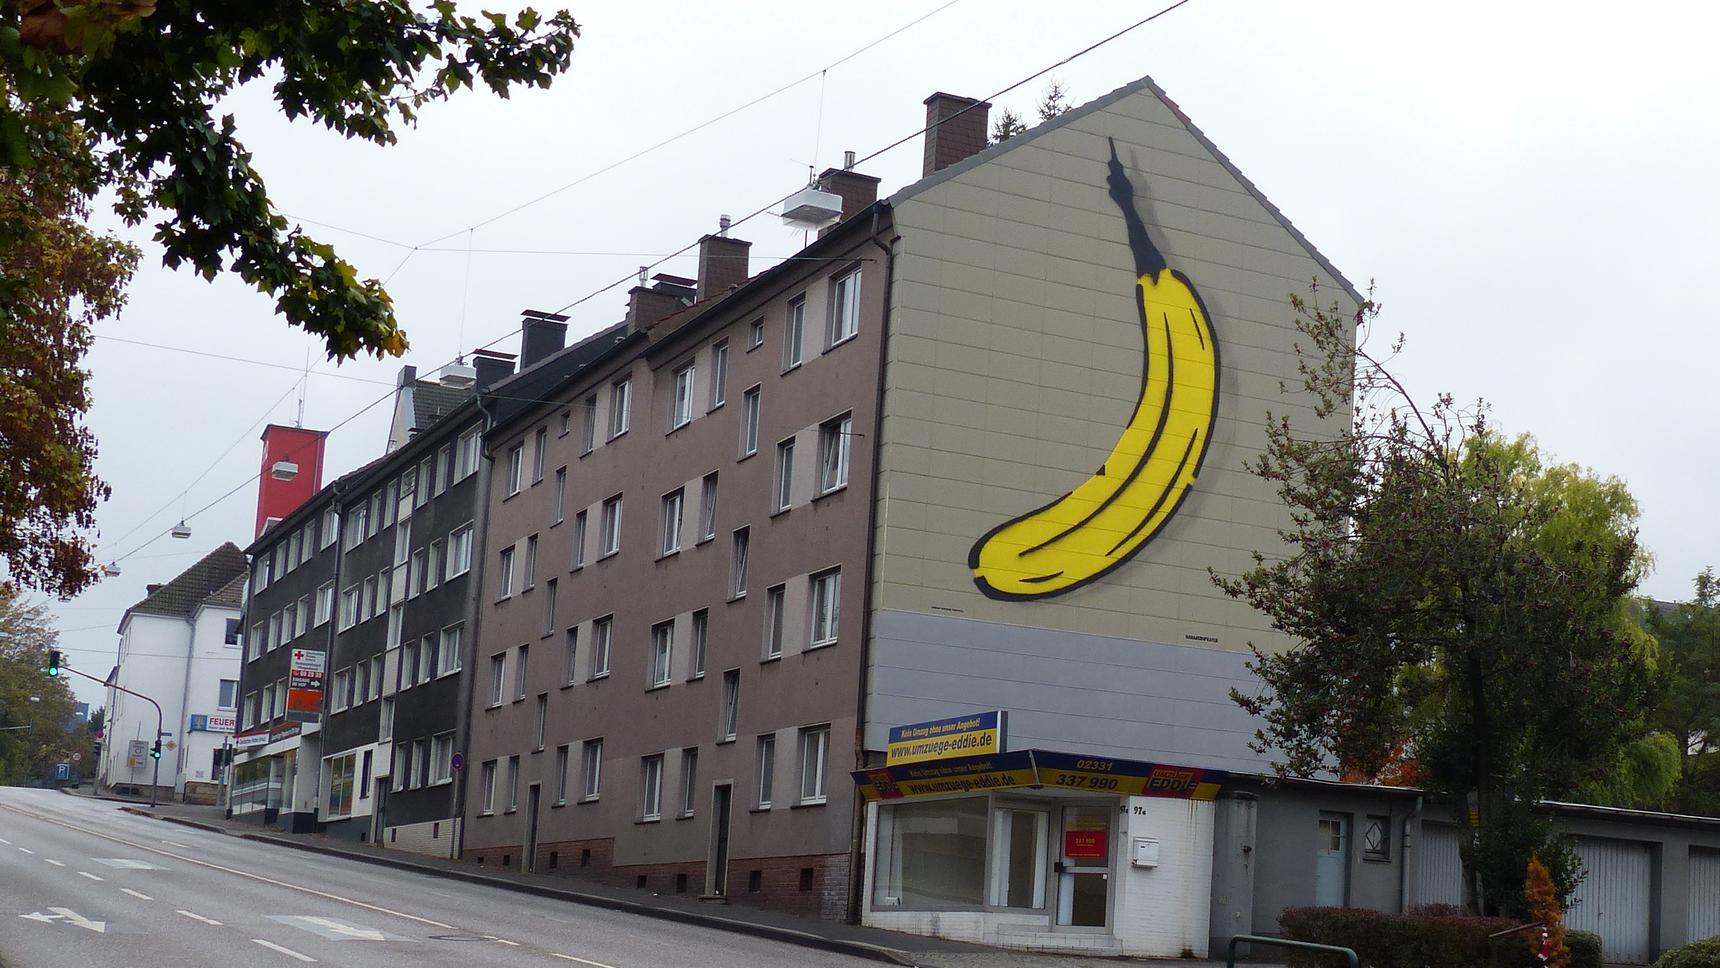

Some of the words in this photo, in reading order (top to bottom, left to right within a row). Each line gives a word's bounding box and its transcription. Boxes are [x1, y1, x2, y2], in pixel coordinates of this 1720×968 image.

[891, 732, 993, 759] www.umzuege-eddie.de
[1076, 759, 1113, 772] 02331
[910, 773, 1016, 795] www.umzuege-eddie.de
[1055, 773, 1086, 787] 337
[1088, 776, 1119, 791] 990
